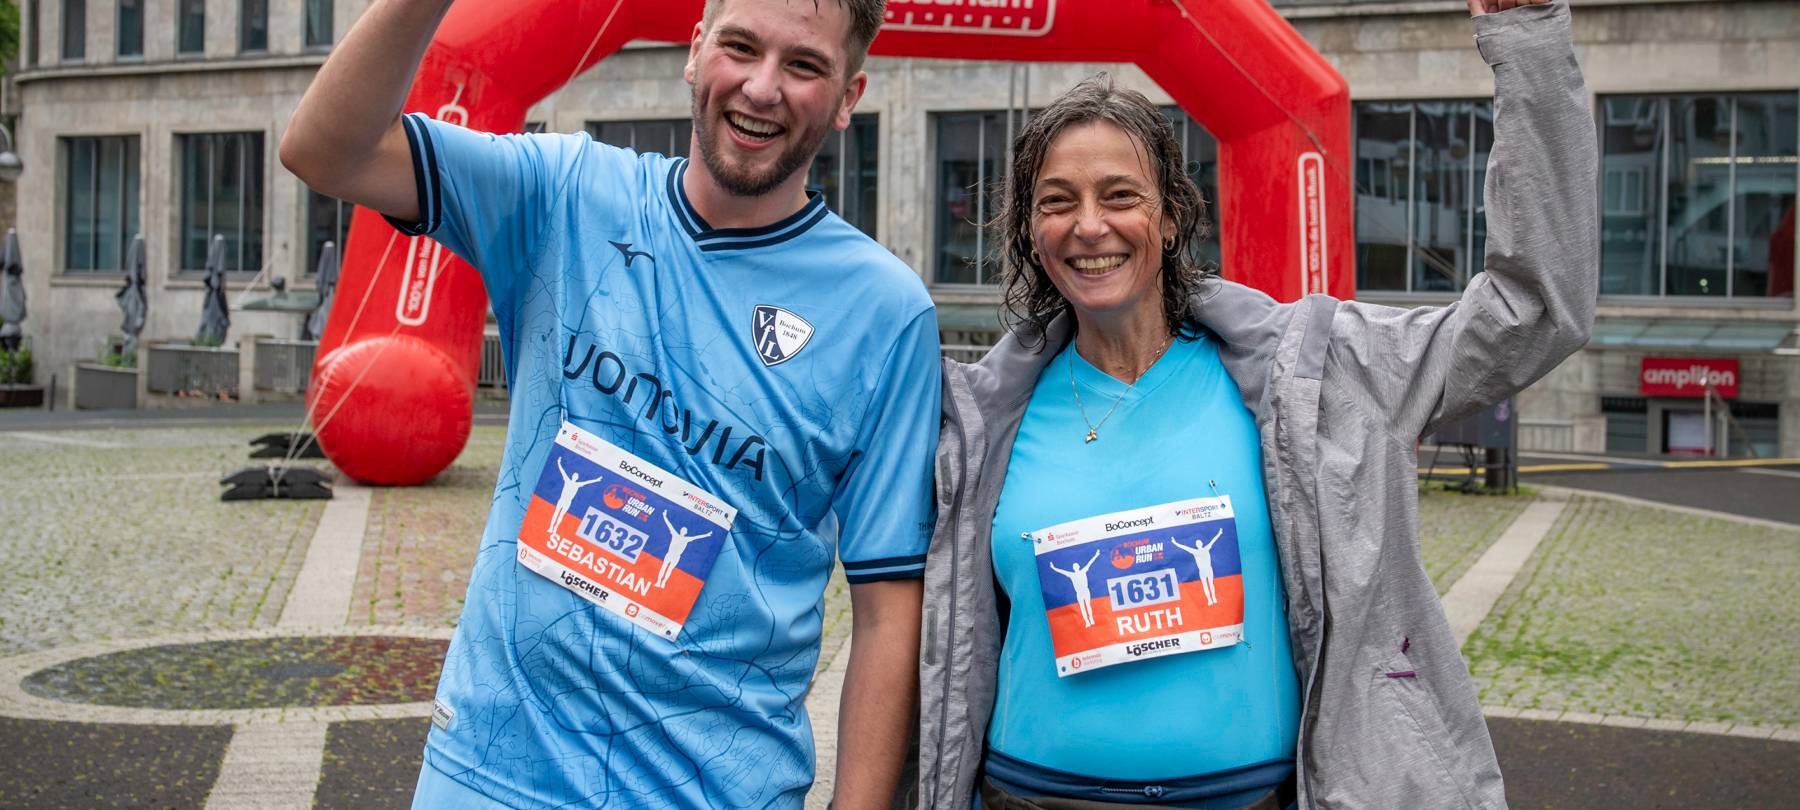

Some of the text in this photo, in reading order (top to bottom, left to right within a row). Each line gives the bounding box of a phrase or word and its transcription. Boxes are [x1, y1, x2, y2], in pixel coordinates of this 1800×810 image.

[1643, 366, 1734, 389] amplifon
[619, 460, 664, 488] BoConcept
[622, 504, 640, 517] RUN
[627, 496, 655, 515] URBAN
[1105, 516, 1155, 532] BoConcept
[583, 513, 644, 560] 1632
[1135, 543, 1164, 555] URBAN
[1135, 553, 1153, 564] RUN
[546, 533, 652, 597] SEBASTIAN
[560, 570, 609, 601] LÖSCHER
[1111, 573, 1175, 606] 1631
[1116, 607, 1184, 636] RUTH
[1126, 638, 1181, 657] LÖSCHER
